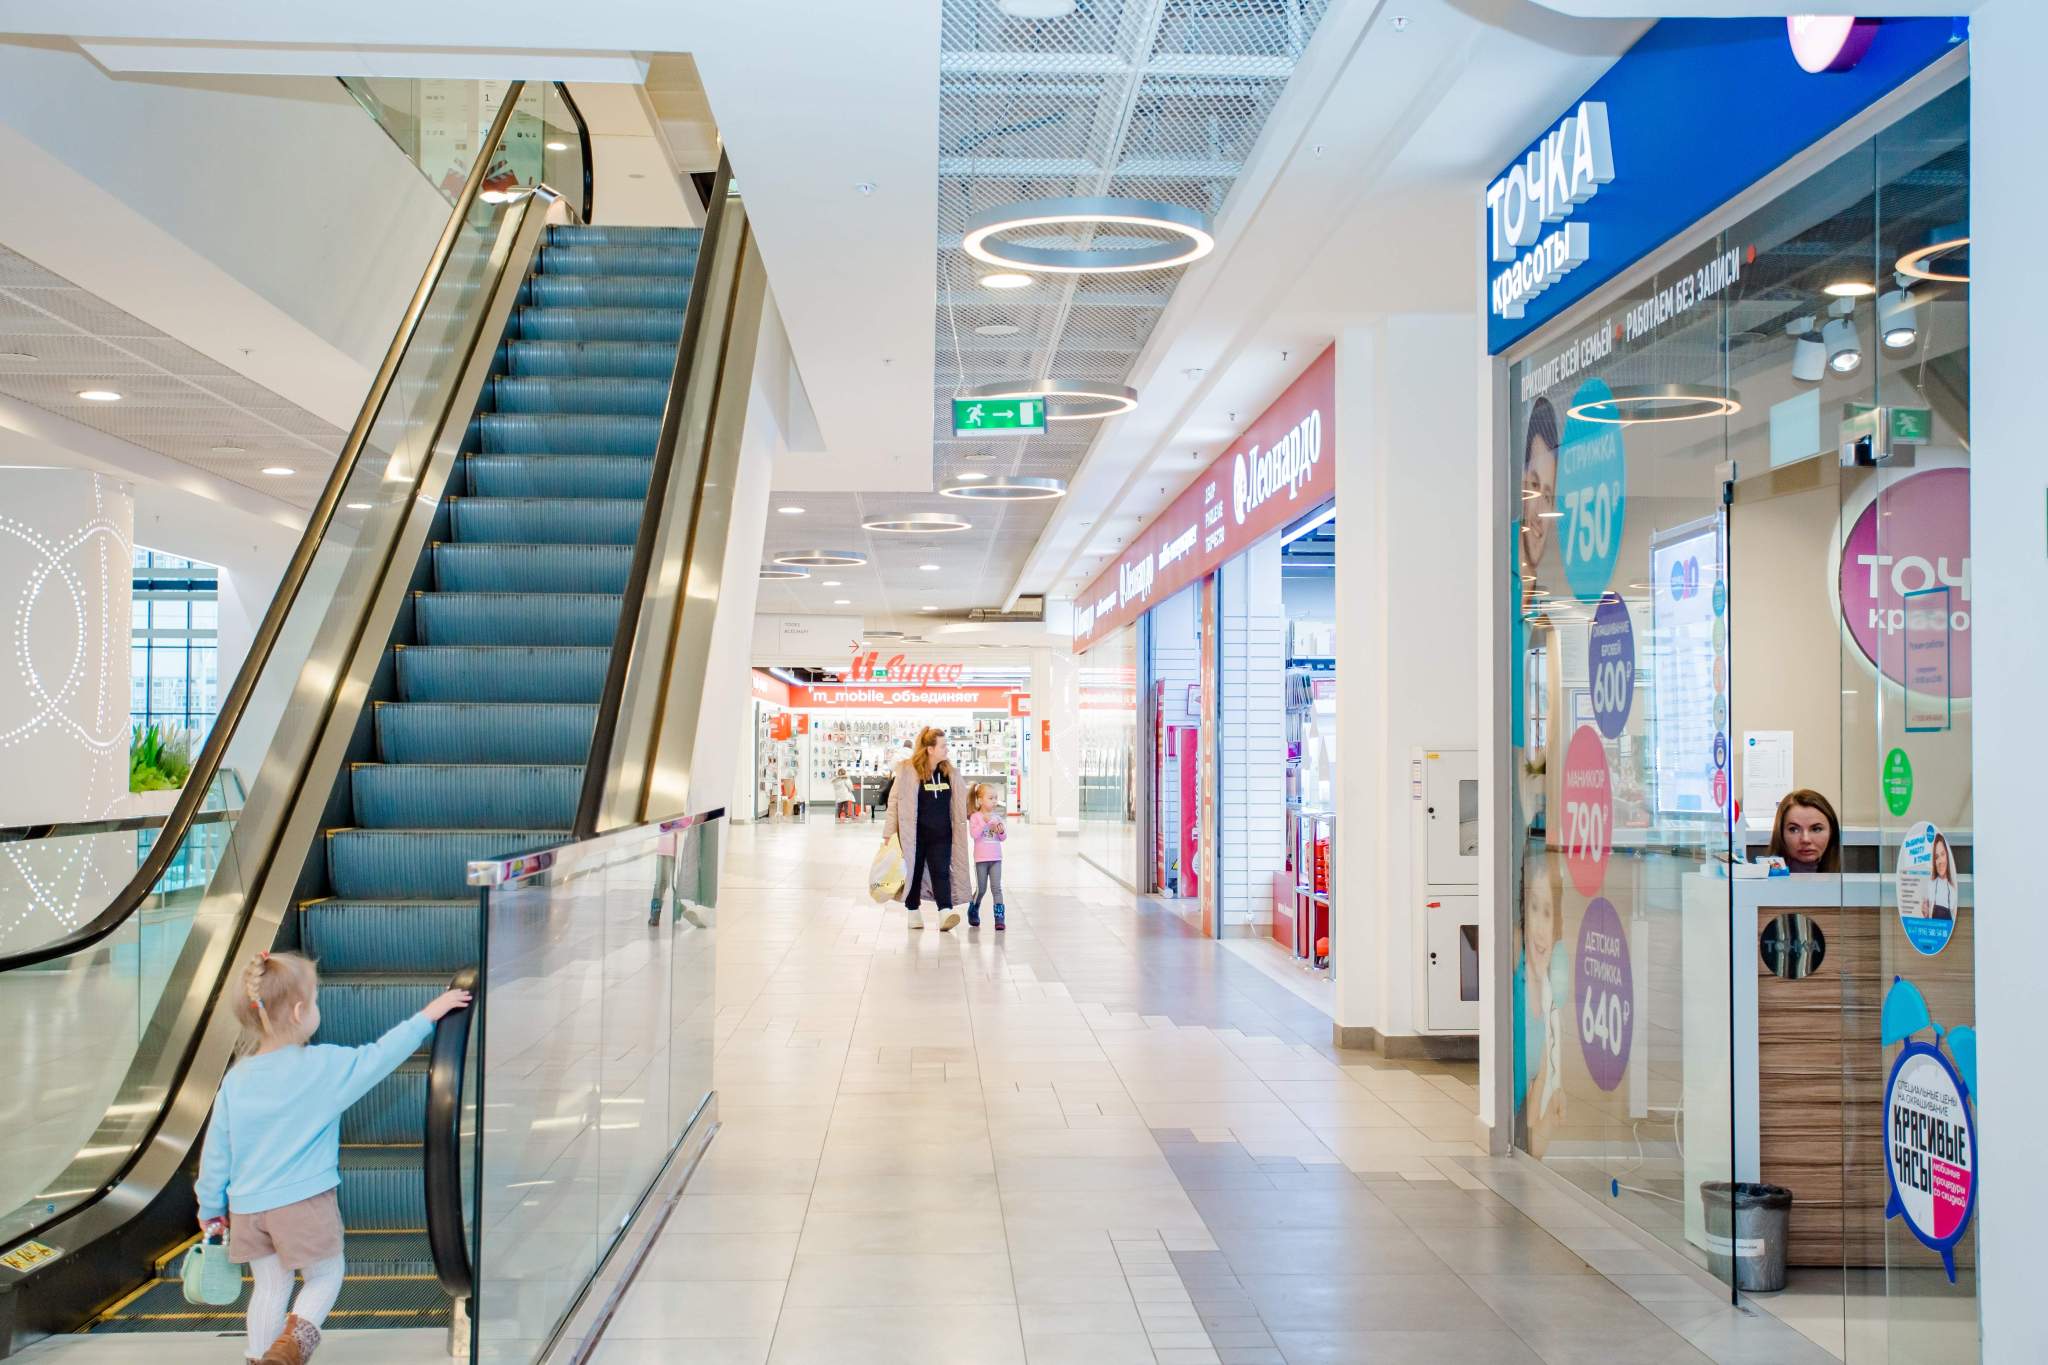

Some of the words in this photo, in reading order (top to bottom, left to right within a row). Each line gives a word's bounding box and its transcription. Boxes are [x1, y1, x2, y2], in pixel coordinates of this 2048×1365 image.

[1487, 101, 1602, 262] ТОЧКА
[1492, 223, 1577, 317] красоты
[1521, 356, 1559, 402] ПРИХОДИТЕ
[1560, 338, 1580, 380] ВСЕЙ
[1581, 318, 1612, 369] СЕМЬЕЙ
[1626, 286, 1674, 342] РАБОТАЕМ
[1676, 274, 1695, 314] БЕЗ
[1697, 246, 1740, 302] ЗАПИСИ
[1246, 408, 1322, 512] Леонардо
[1564, 430, 1617, 475] СТРИЖКА
[1566, 768, 1605, 789] МАНИКЮР
[1584, 930, 1620, 960] ДЕТСКАЯ
[1584, 956, 1622, 986] СТРИЖКА
[1894, 1104, 1966, 1166] КРАСИВЫЕ
[1895, 1143, 1933, 1195] ЧАСЫ
